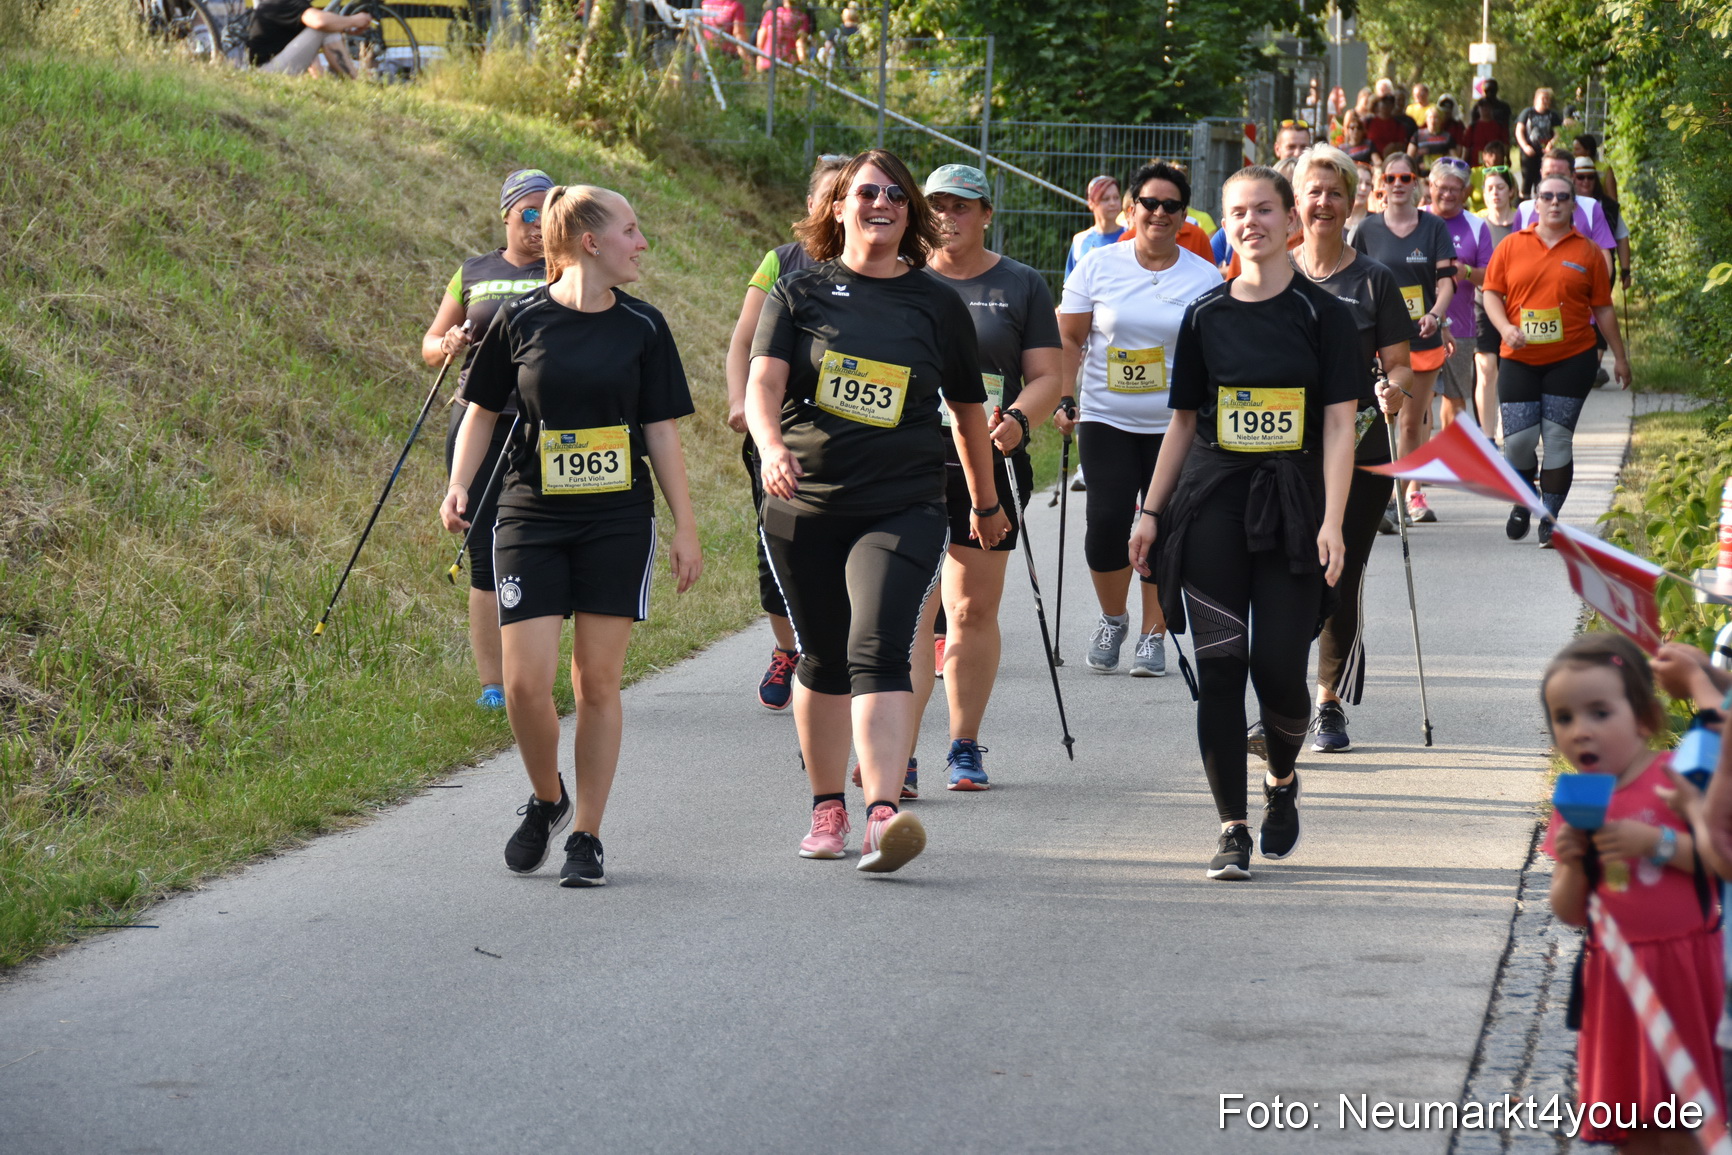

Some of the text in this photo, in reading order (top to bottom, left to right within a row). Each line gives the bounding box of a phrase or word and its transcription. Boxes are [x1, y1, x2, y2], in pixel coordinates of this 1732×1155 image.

[1406, 298, 1414, 310] 3
[1525, 320, 1557, 334] 1795
[1123, 365, 1146, 381] 92
[830, 376, 893, 409] 1953
[835, 405, 851, 413] Wagner
[852, 409, 868, 418] Stiftung
[840, 400, 875, 414] Bauer Anja
[1228, 410, 1292, 434] 1985
[553, 450, 619, 476] 1963
